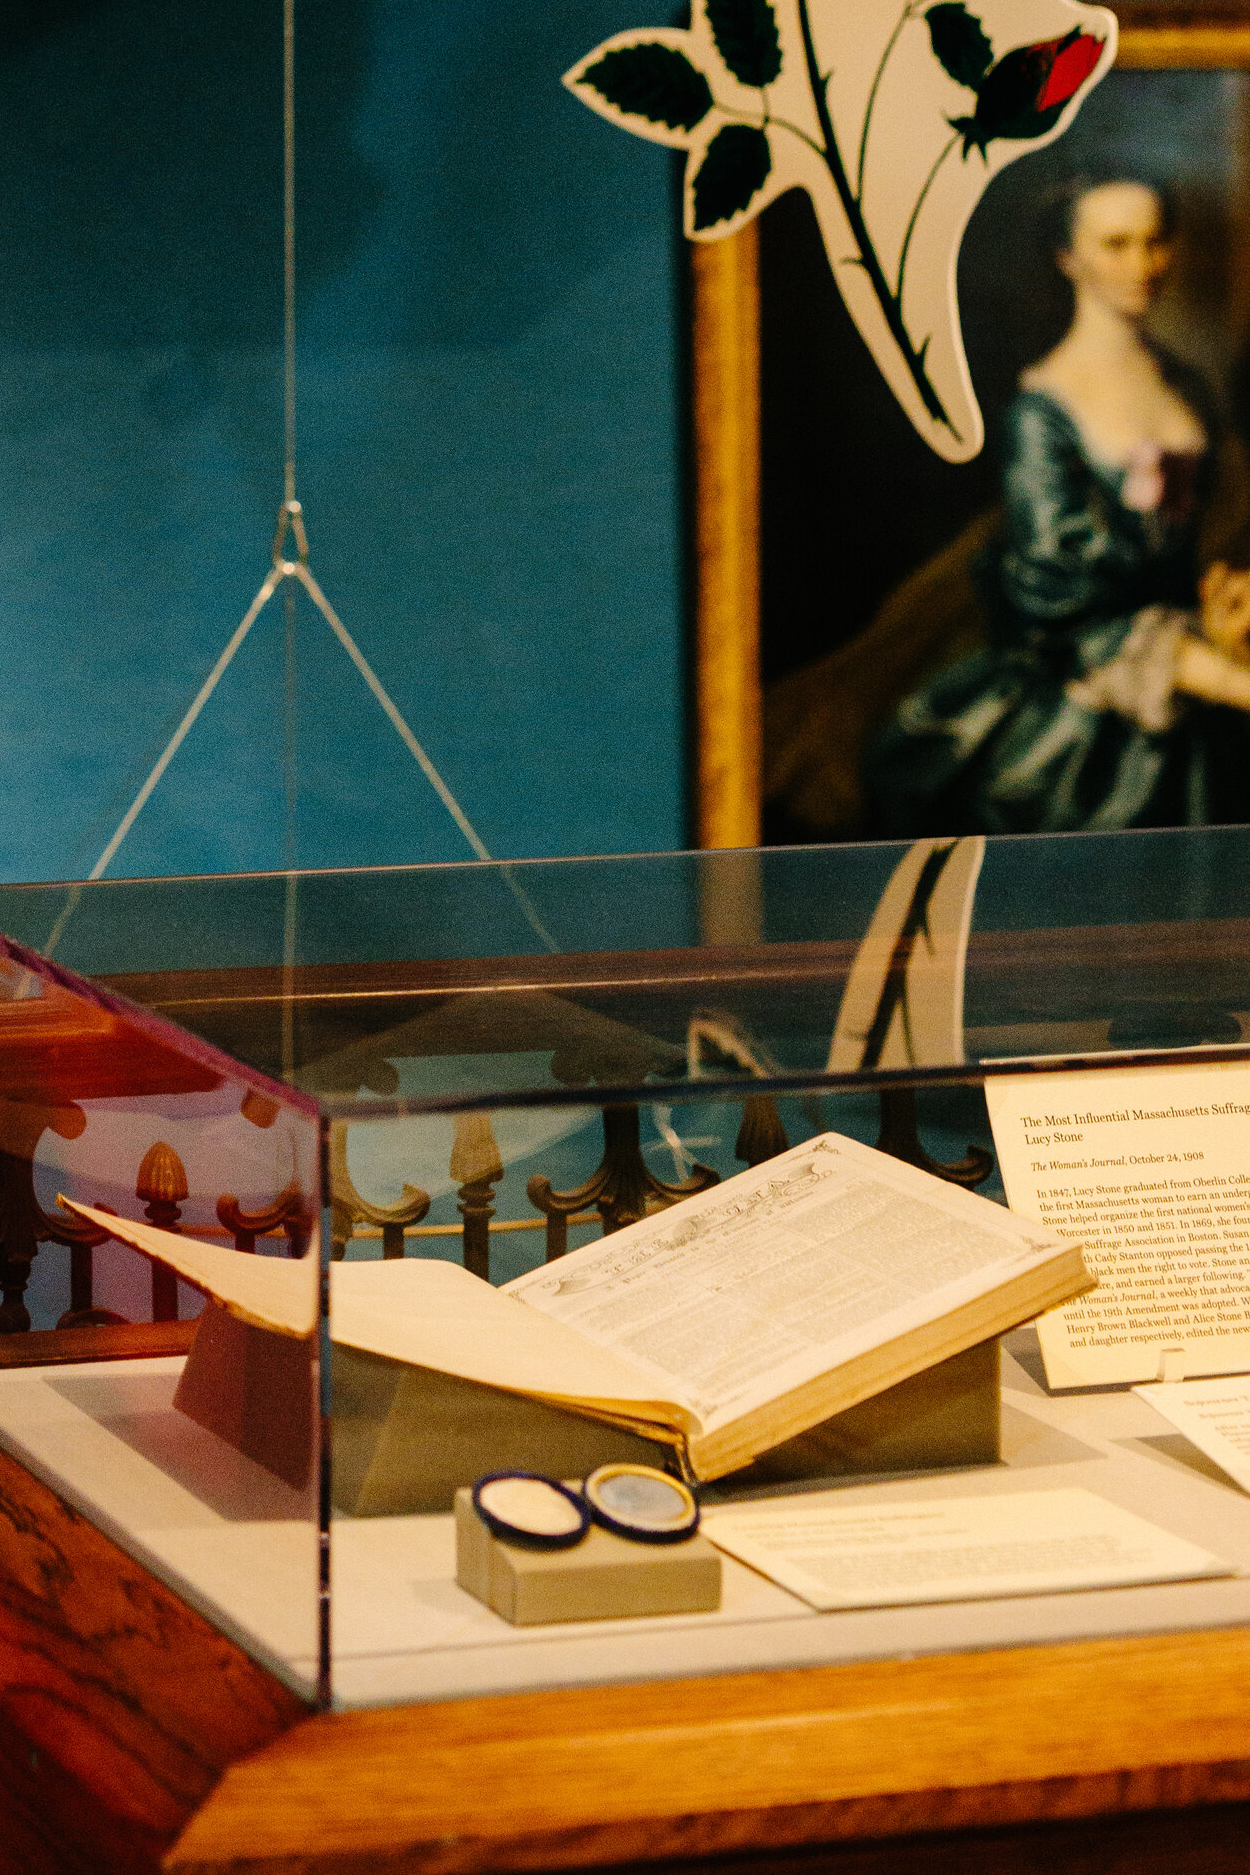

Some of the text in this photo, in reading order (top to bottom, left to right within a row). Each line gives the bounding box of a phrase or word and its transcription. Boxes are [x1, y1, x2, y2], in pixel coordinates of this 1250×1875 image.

[1020, 1116, 1043, 1128] The
[1044, 1115, 1072, 1126] Most
[1073, 1109, 1130, 1125] Influential
[1132, 1106, 1210, 1121] Massachusetts
[1024, 1132, 1083, 1146] Lucy Stone
[1031, 1151, 1205, 1172] The Woman's Journal, October 24, 1908
[1037, 1189, 1047, 1199] In
[1049, 1188, 1072, 1198] 1847,
[1073, 1187, 1095, 1197] Lucy
[1096, 1185, 1121, 1194] Stone
[1123, 1180, 1168, 1194] graduated
[1170, 1179, 1192, 1189] from
[1192, 1176, 1227, 1186] Oberlin
[1039, 1202, 1054, 1212] the
[1056, 1201, 1074, 1211] first
[1075, 1198, 1140, 1210] Massachusetts
[1141, 1195, 1174, 1204] woman
[1175, 1194, 1186, 1202] to
[1187, 1193, 1208, 1202] earn
[1209, 1192, 1221, 1200] an
[1042, 1216, 1068, 1226] Stone
[1069, 1212, 1098, 1225] helped
[1100, 1211, 1138, 1223] organize
[1140, 1209, 1155, 1218] the
[1156, 1208, 1175, 1217] first
[1176, 1204, 1213, 1216] national
[1056, 1228, 1100, 1238] Worcester
[1102, 1226, 1112, 1235] in
[1113, 1224, 1134, 1234] 1850
[1137, 1223, 1154, 1232] and
[1156, 1221, 1177, 1231] 1851.
[1179, 1220, 1190, 1229] In
[1192, 1219, 1215, 1228] 1869,
[1216, 1216, 1231, 1226] she
[1084, 1230, 1250, 1250] Suffrage Association in Boston. Susan
[1095, 1252, 1118, 1264] Cady
[1119, 1251, 1154, 1261] Stanton
[1156, 1246, 1193, 1260] opposed
[1195, 1245, 1228, 1257] passing
[1229, 1243, 1244, 1252] the
[1090, 1266, 1114, 1277] black
[1116, 1267, 1136, 1275] men
[1137, 1263, 1152, 1273] the
[1154, 1261, 1176, 1273] right
[1178, 1262, 1187, 1270] to
[1189, 1260, 1210, 1269] vote.
[1211, 1258, 1236, 1267] Stone
[1116, 1278, 1133, 1288] and
[1134, 1276, 1165, 1287] earned
[1174, 1275, 1200, 1285] larger
[1080, 1294, 1118, 1305] Woman's
[1120, 1290, 1159, 1302] Journal,
[1167, 1287, 1198, 1298] weekly
[1199, 1286, 1218, 1296] that
[1063, 1309, 1085, 1321] until
[1087, 1309, 1101, 1318] the
[1103, 1307, 1123, 1318] 19th
[1125, 1304, 1179, 1316] Amendment
[1182, 1302, 1199, 1310] was
[1201, 1297, 1239, 1310] adopted.
[1066, 1324, 1095, 1335] Henry
[1097, 1322, 1127, 1332] Brown
[1128, 1317, 1171, 1329] Blackwell
[1173, 1315, 1190, 1325] and
[1193, 1314, 1215, 1324] Alice
[1216, 1312, 1242, 1322] Stone
[1070, 1337, 1087, 1348] and
[1089, 1335, 1128, 1347] daughter
[1130, 1330, 1185, 1344] respectively,
[1186, 1327, 1214, 1338] edited
[1215, 1326, 1230, 1335] the
